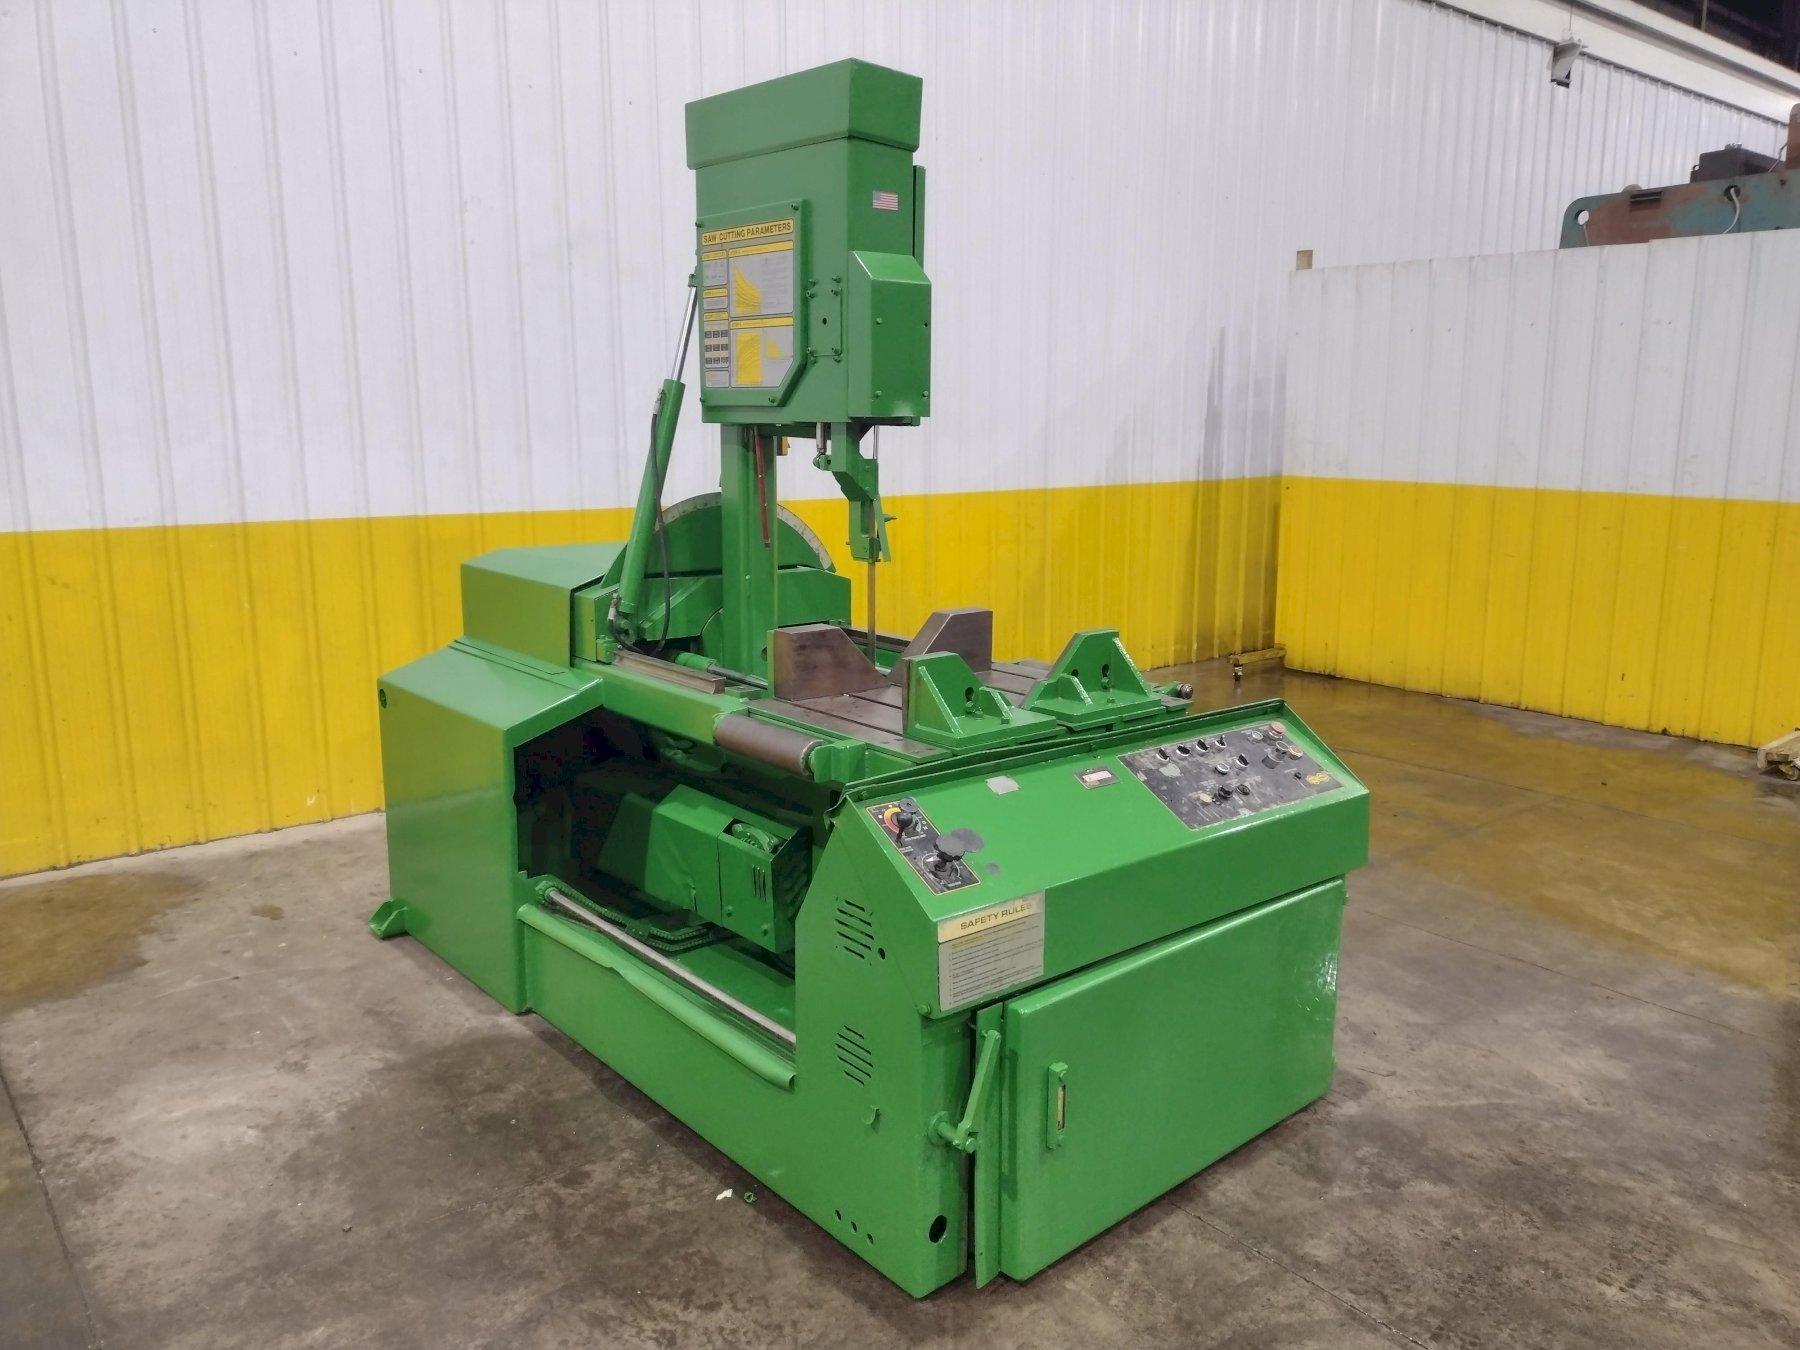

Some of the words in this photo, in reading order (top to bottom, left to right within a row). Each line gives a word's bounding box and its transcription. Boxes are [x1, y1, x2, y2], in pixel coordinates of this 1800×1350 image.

[703, 235, 716, 243] SAW
[719, 229, 745, 241] CUTTING
[747, 222, 791, 236] PARAMETERS
[960, 912, 999, 930] SAFETY
[1001, 904, 1032, 917] RULES
